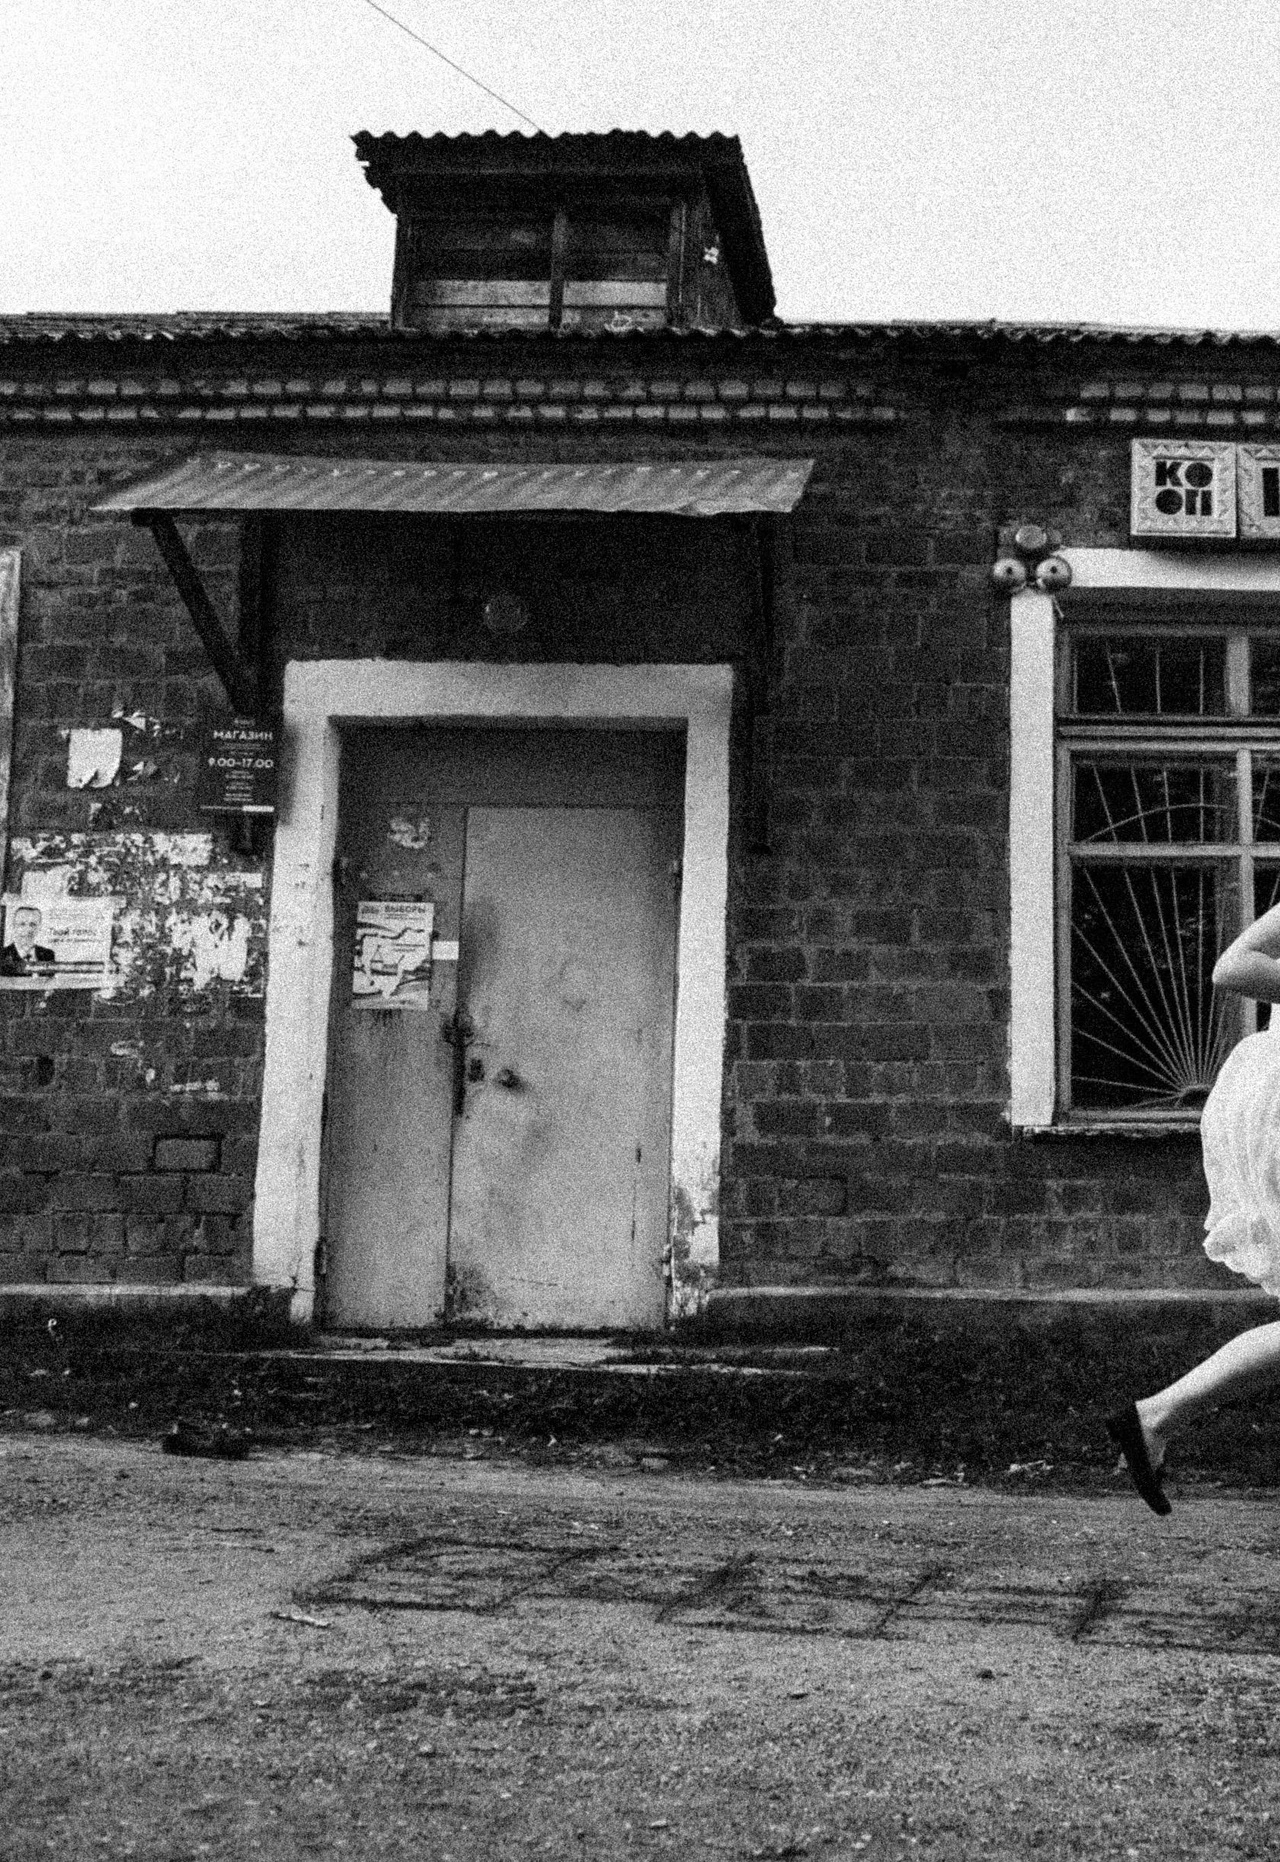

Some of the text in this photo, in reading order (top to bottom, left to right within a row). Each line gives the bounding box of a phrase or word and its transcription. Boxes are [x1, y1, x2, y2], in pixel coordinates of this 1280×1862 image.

[1154, 460, 1213, 488] КО
[1154, 488, 1213, 516] ОП
[212, 729, 273, 741] МАГАЗИН
